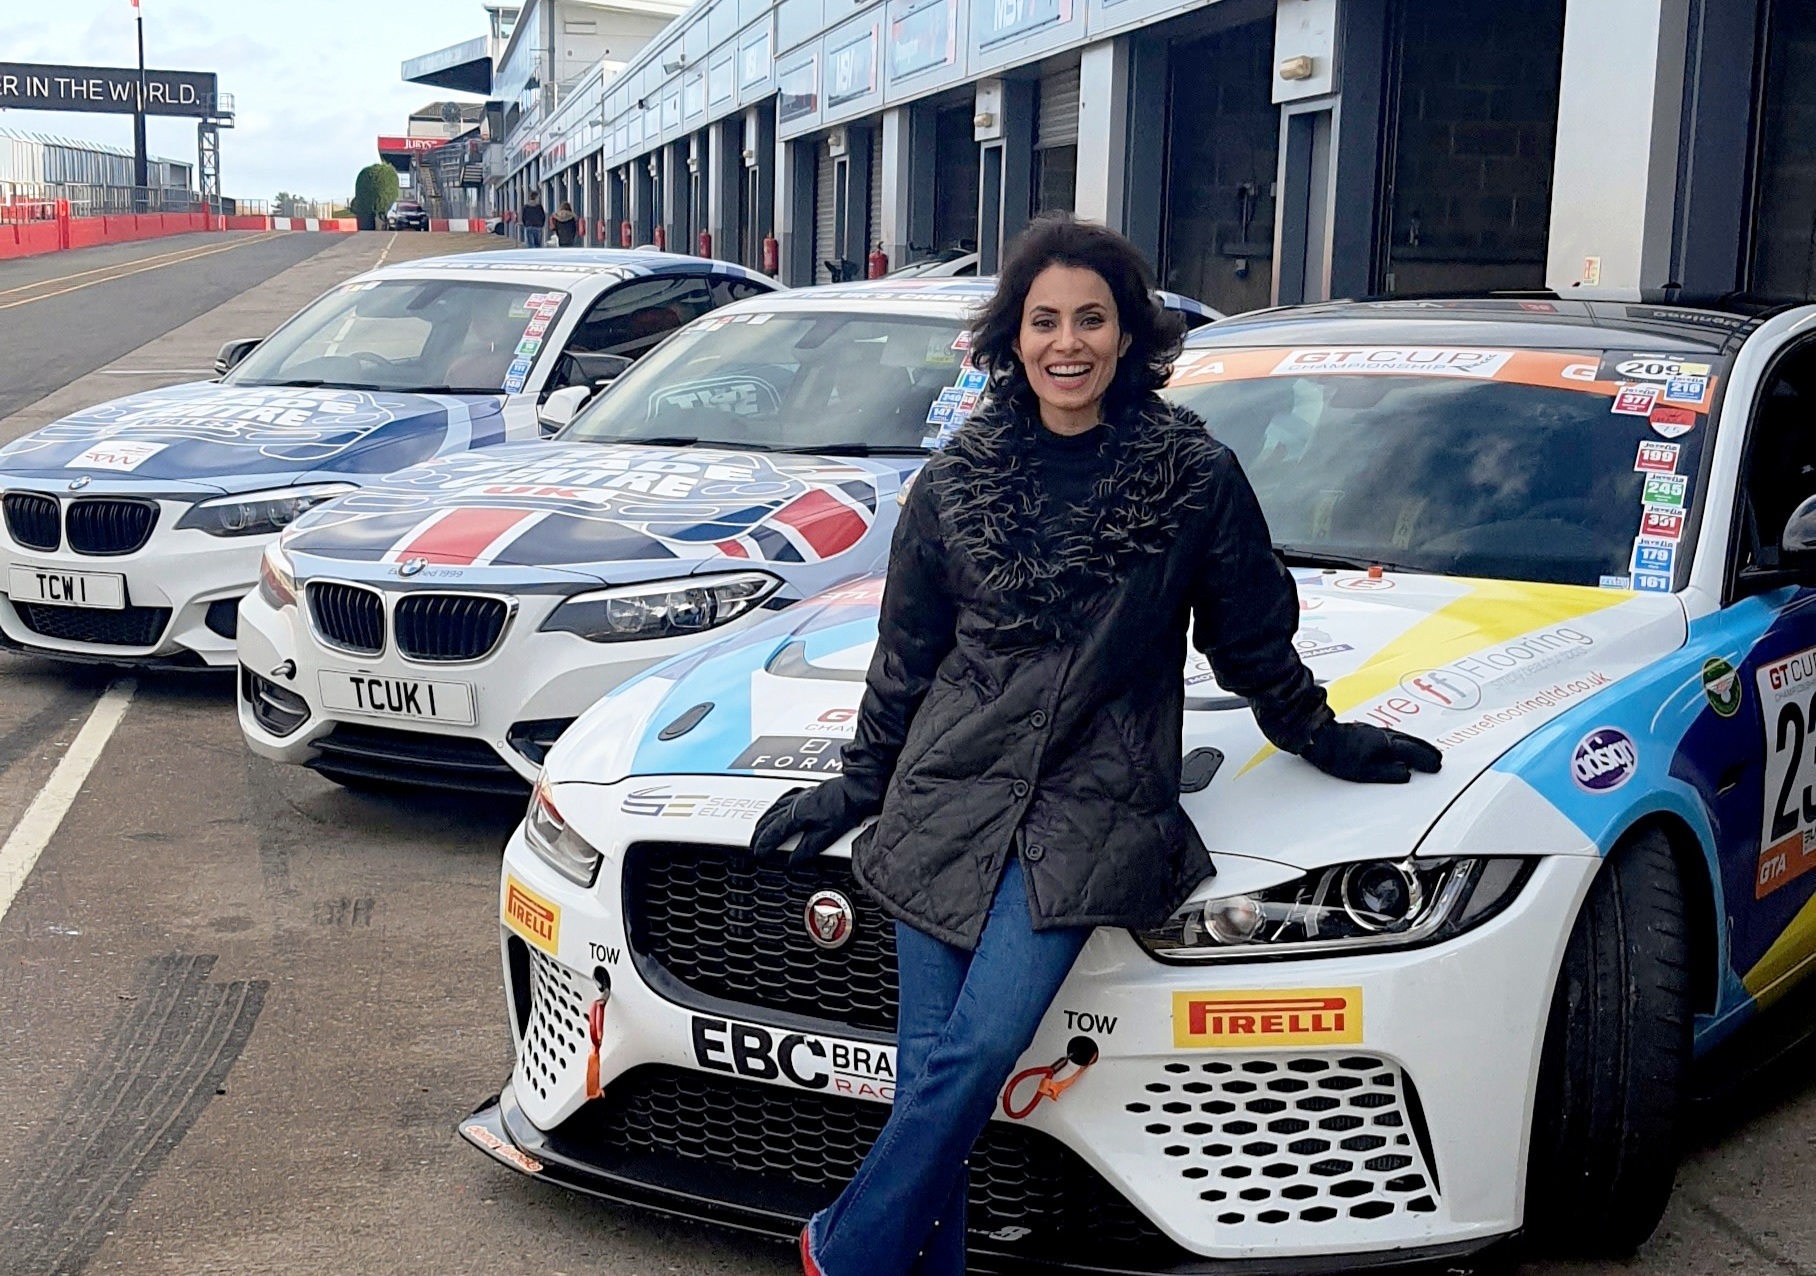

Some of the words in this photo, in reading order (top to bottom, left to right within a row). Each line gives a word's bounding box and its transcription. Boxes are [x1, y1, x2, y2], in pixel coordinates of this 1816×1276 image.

[0, 76, 19, 97] R
[26, 76, 49, 98] IN
[53, 77, 104, 100] THE
[1288, 363, 1447, 371] CHAMPIONSHIP
[1622, 394, 1651, 405] 377
[1641, 449, 1674, 463] 199
[439, 469, 700, 498] CENTRE
[482, 486, 587, 498] UK
[1647, 481, 1683, 496] 245
[1647, 514, 1677, 528] 351
[1641, 548, 1669, 561] 179
[36, 573, 74, 601] TCW
[1455, 627, 1594, 680] Flooring
[349, 676, 422, 715] TCUK
[1439, 670, 1613, 752] .futureflooringltd.co.uk
[1575, 736, 1636, 783] adsign
[698, 807, 759, 820] ELITE
[1759, 852, 1787, 885] GTA
[507, 883, 555, 942] PIRELLI
[588, 941, 621, 965] TOW
[1062, 1009, 1118, 1035] TOW
[1188, 996, 1348, 1036] PIRELLI
[691, 1014, 830, 1090] EBC
[832, 1042, 895, 1078] BRA
